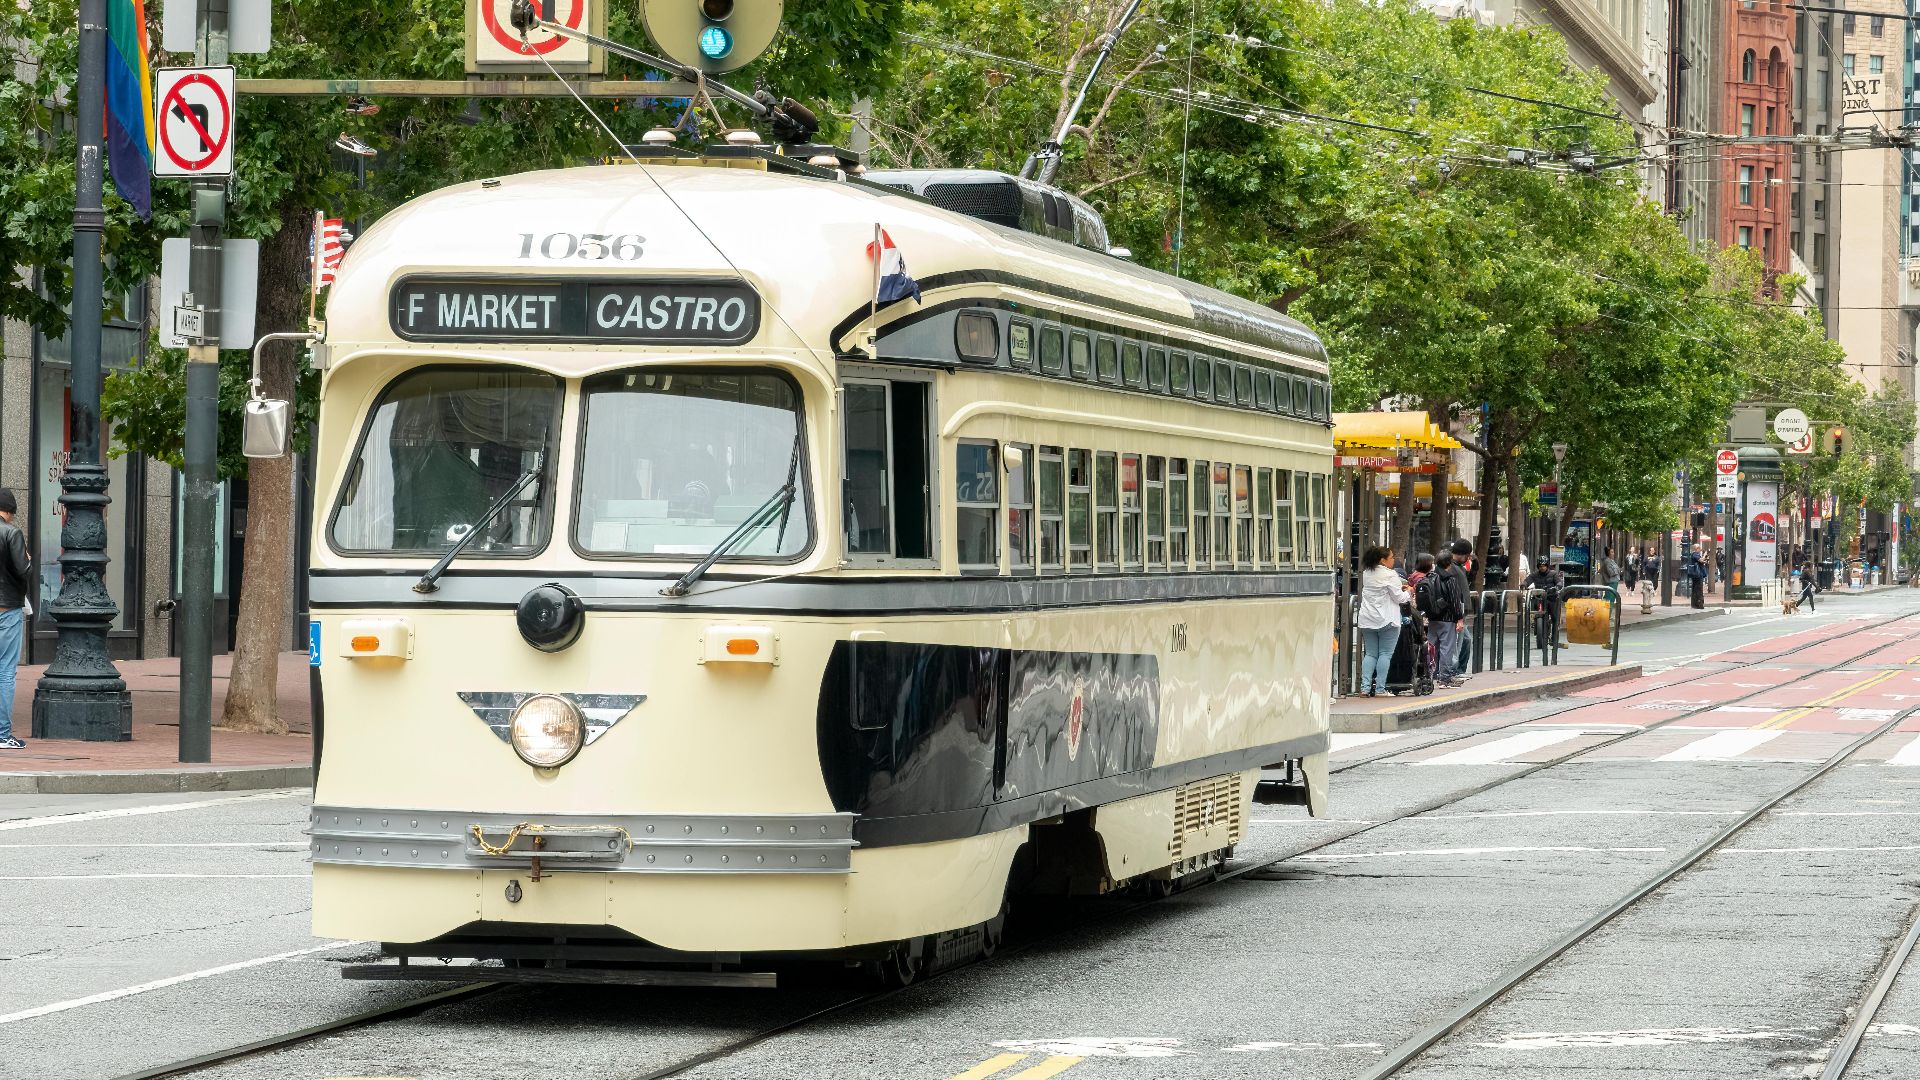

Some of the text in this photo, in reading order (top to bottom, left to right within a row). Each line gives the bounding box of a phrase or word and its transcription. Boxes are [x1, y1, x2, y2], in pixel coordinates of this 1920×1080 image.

[516, 232, 647, 261] 1056
[408, 293, 747, 333] F MARKET CASTRO
[1171, 622, 1188, 652] 1056
